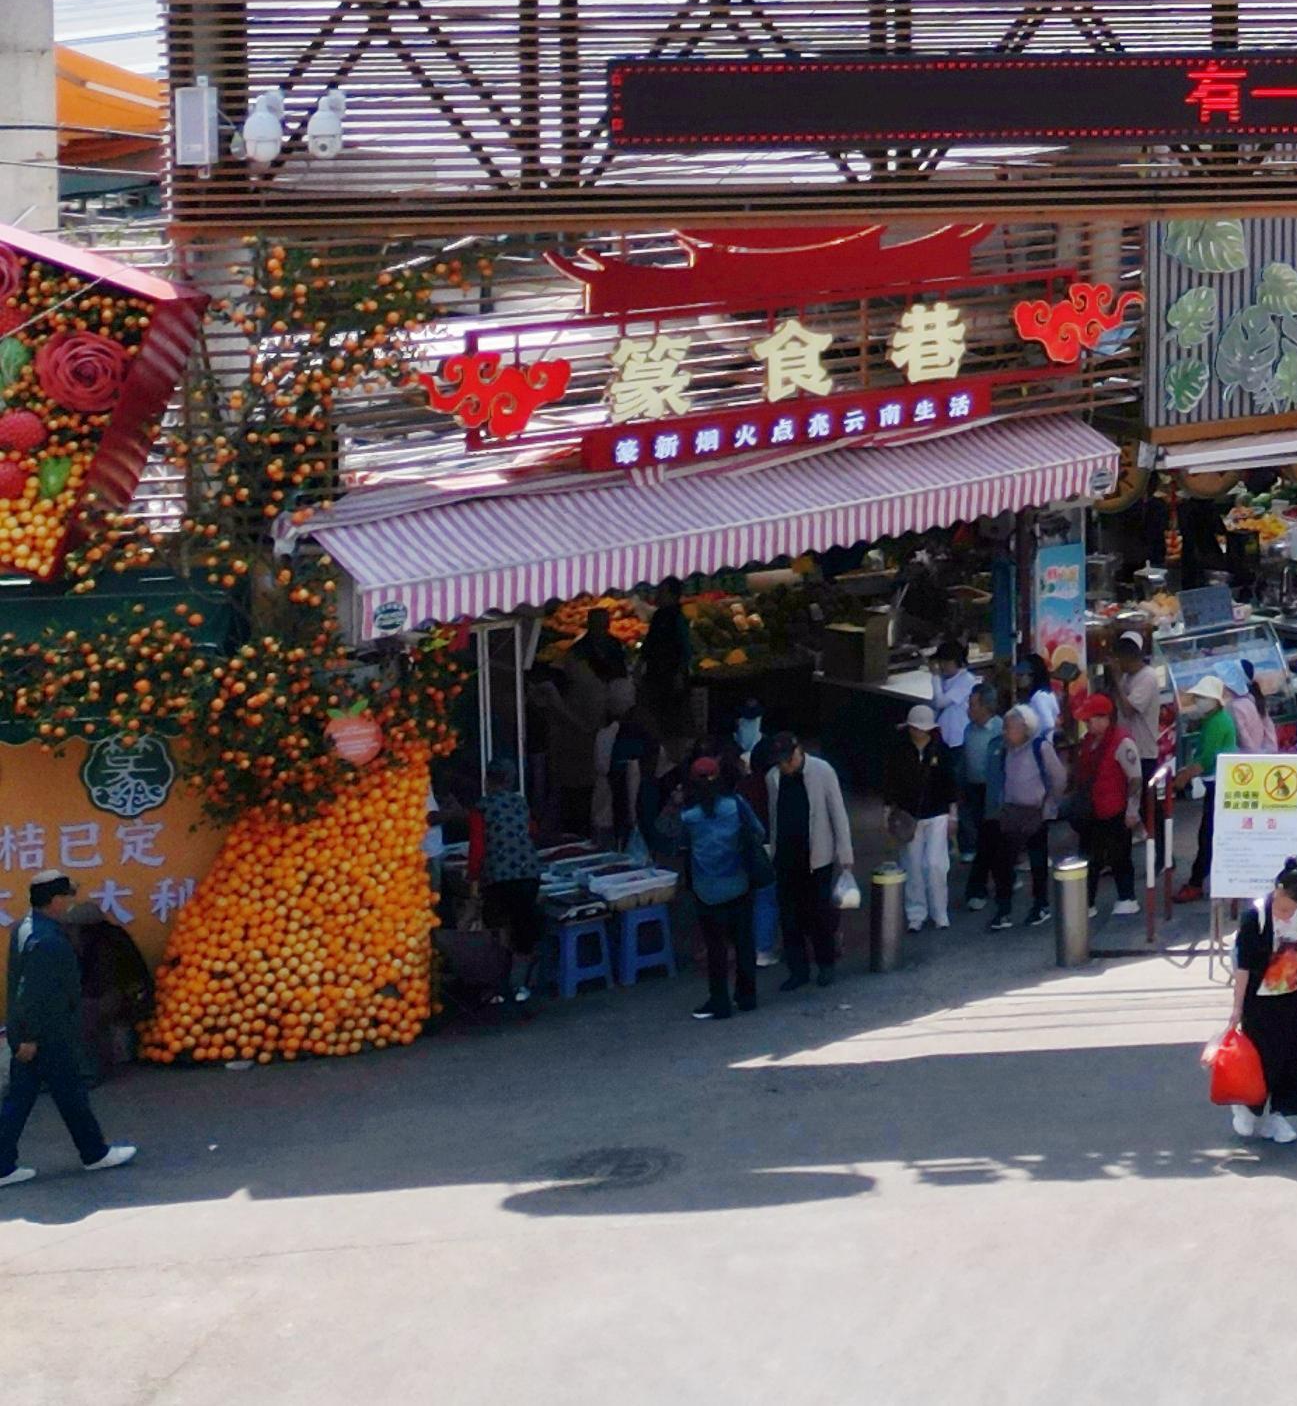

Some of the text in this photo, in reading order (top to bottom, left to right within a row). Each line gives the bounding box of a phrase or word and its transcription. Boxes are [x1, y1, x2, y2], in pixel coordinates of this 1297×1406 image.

[604, 302, 967, 426] 篆食巷
[614, 393, 973, 466] 篆新烟火点亮云南生活
